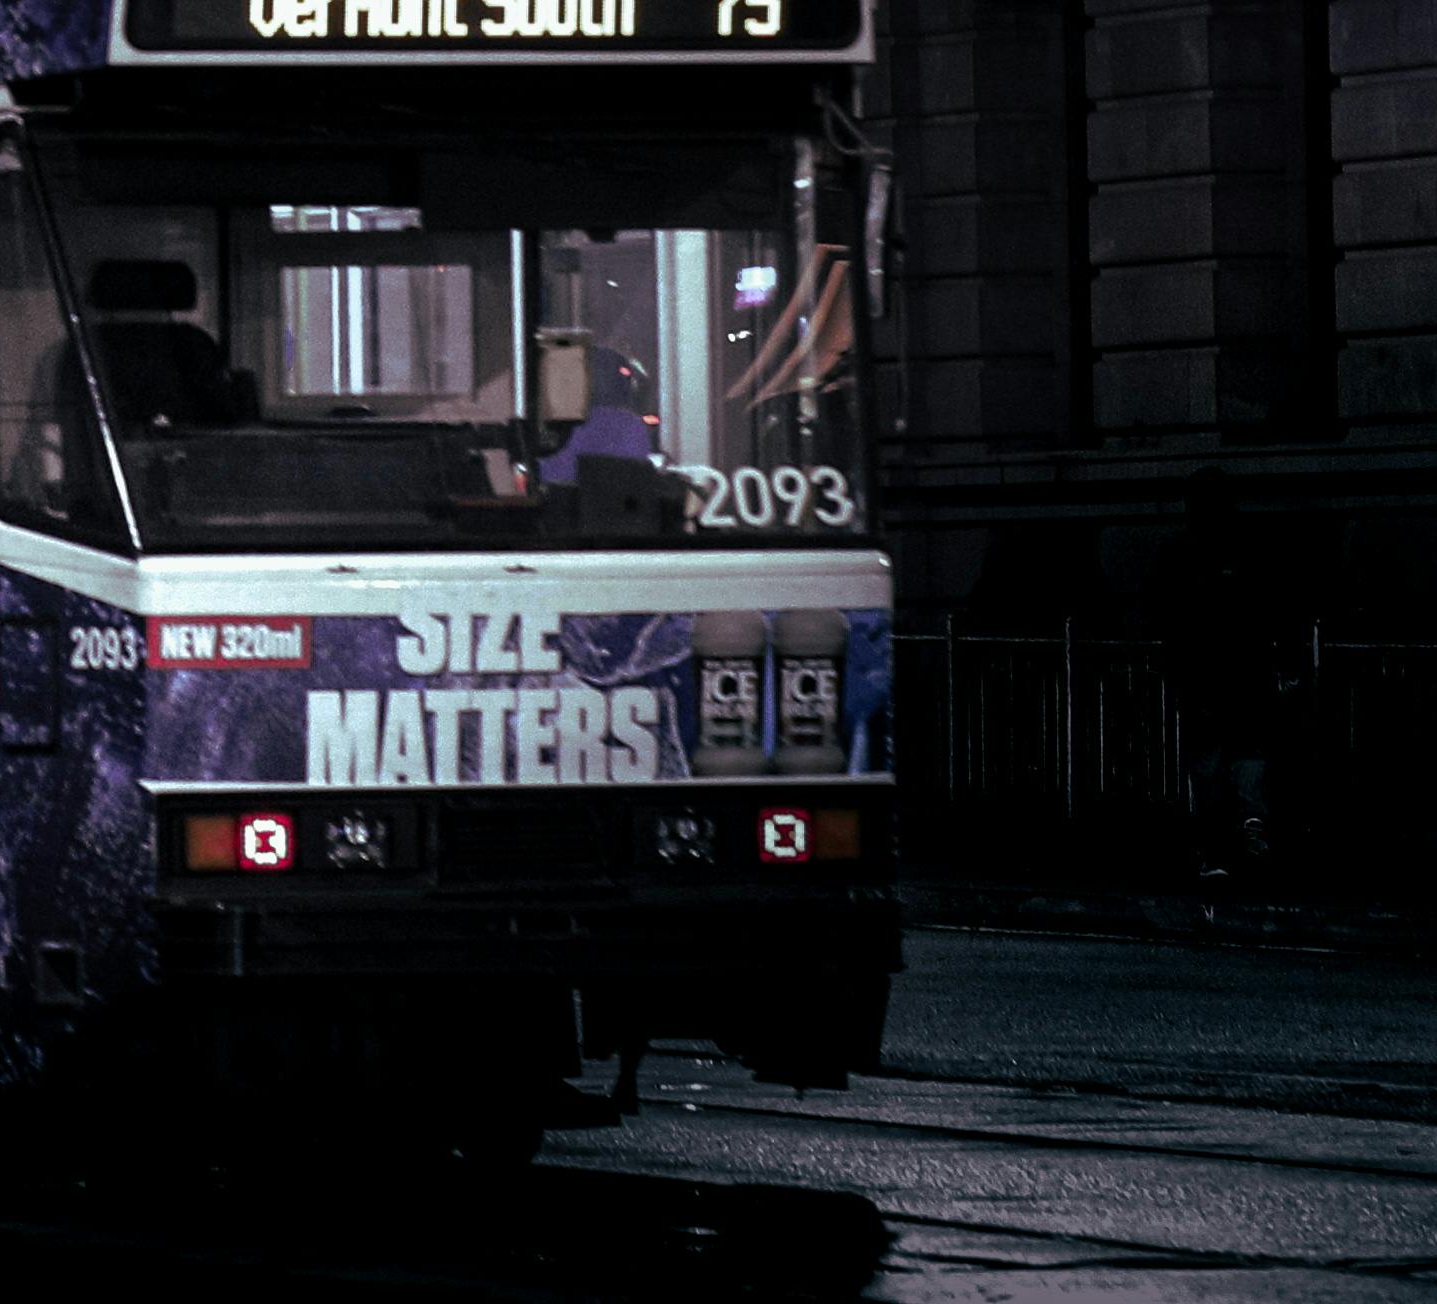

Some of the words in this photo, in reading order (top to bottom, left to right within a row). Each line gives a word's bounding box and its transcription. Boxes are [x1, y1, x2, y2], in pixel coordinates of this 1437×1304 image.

[699, 466, 854, 527] 2093
[70, 626, 137, 670] 2093
[161, 623, 216, 659] NEW
[221, 621, 302, 659] 320ml
[396, 610, 563, 676] SIZE
[306, 688, 660, 784] MATTERS
